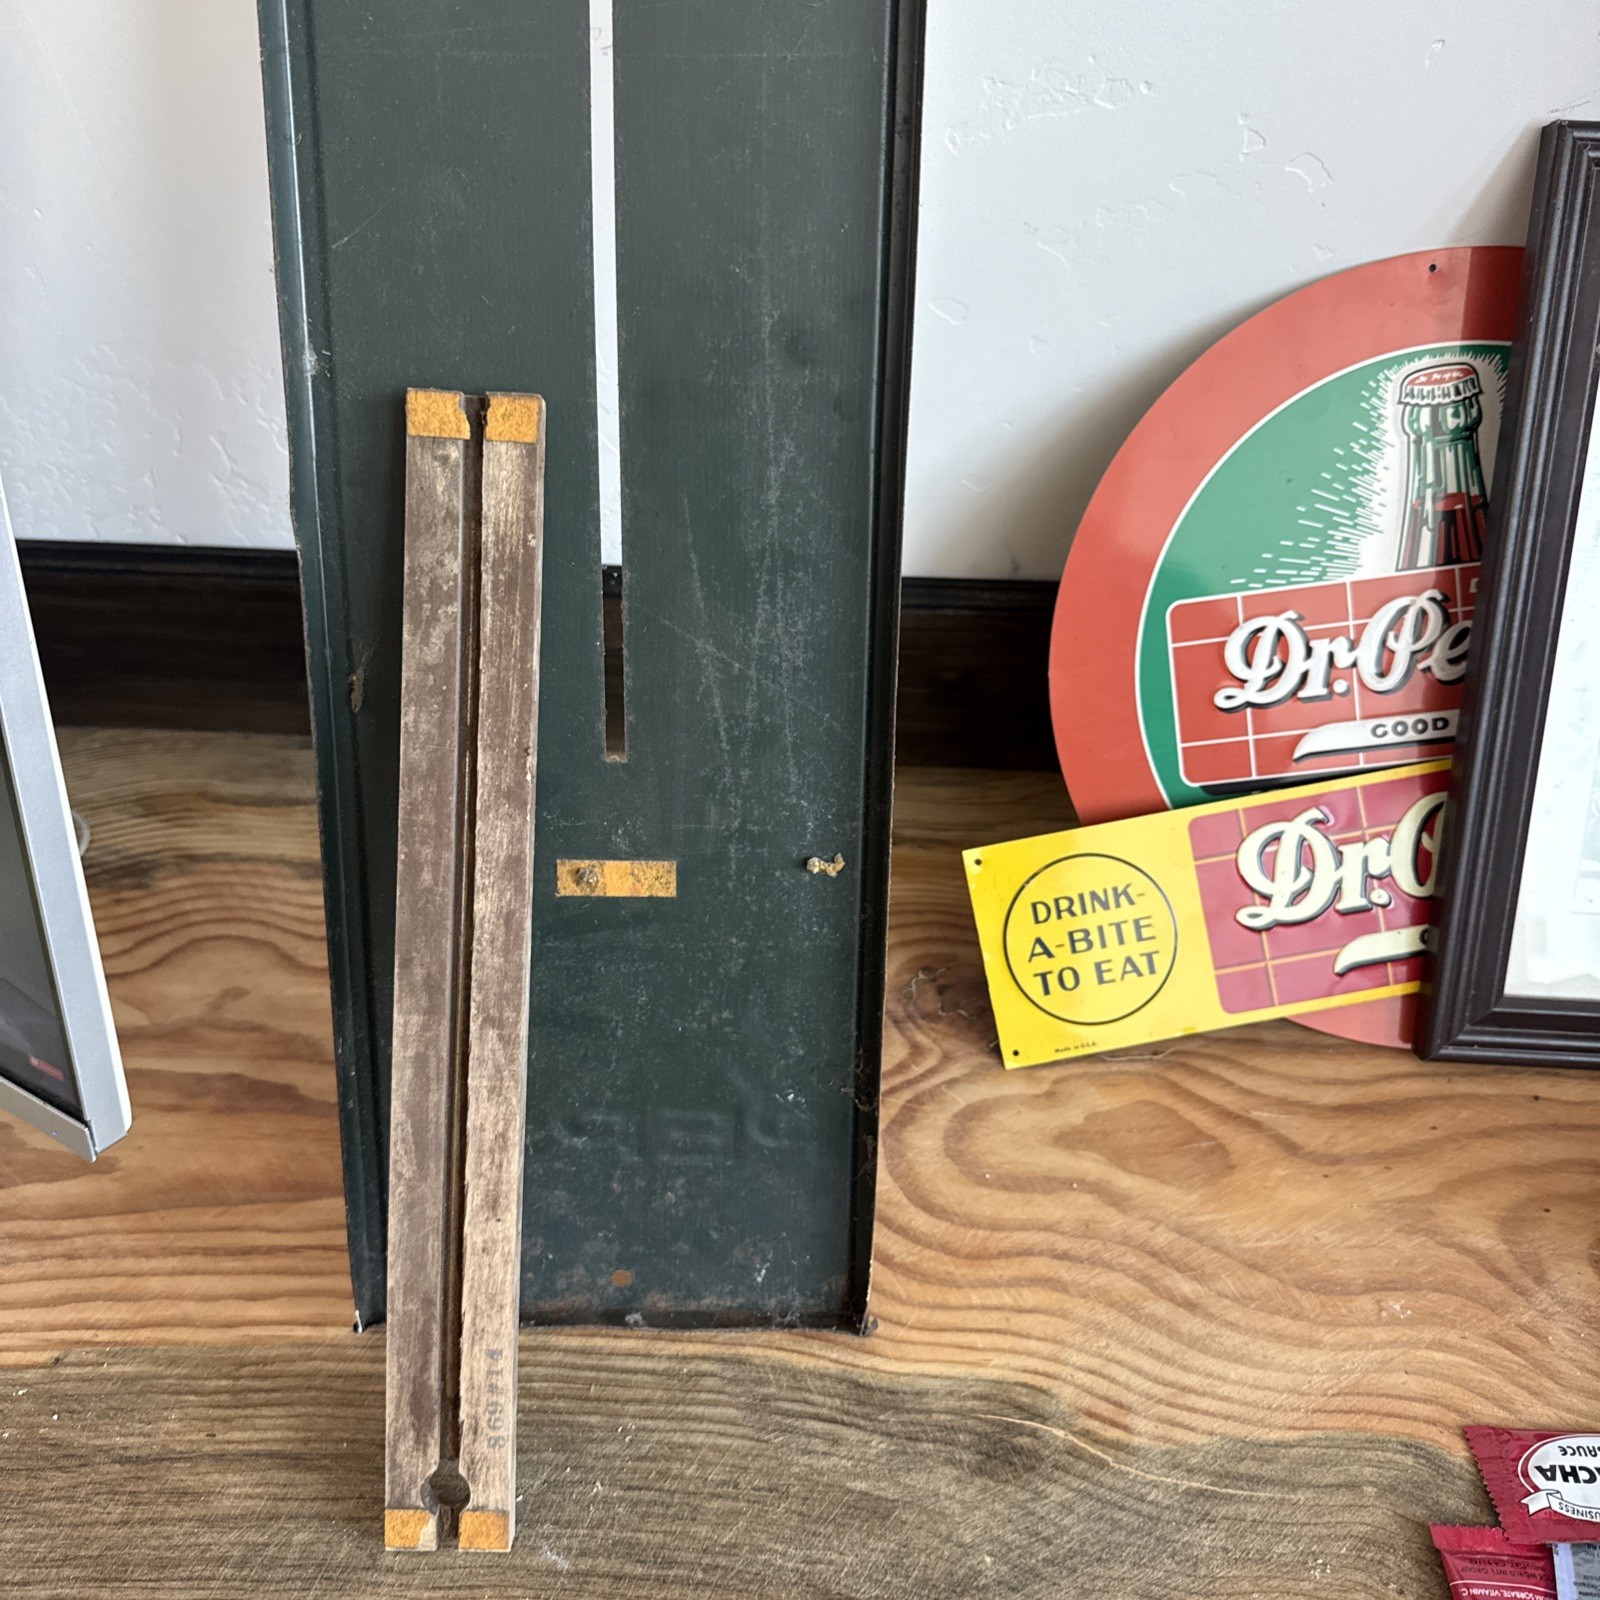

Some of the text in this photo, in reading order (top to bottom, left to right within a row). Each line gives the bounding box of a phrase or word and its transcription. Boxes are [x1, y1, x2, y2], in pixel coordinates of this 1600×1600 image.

[1371, 717, 1449, 738] GOOD
[1030, 883, 1145, 925] DRINK-
[1028, 915, 1156, 963] A-BITE
[1033, 950, 1160, 996] TO EAT
[1558, 1445, 1600, 1458] AUCE
[1534, 1464, 1600, 1484] CHA
